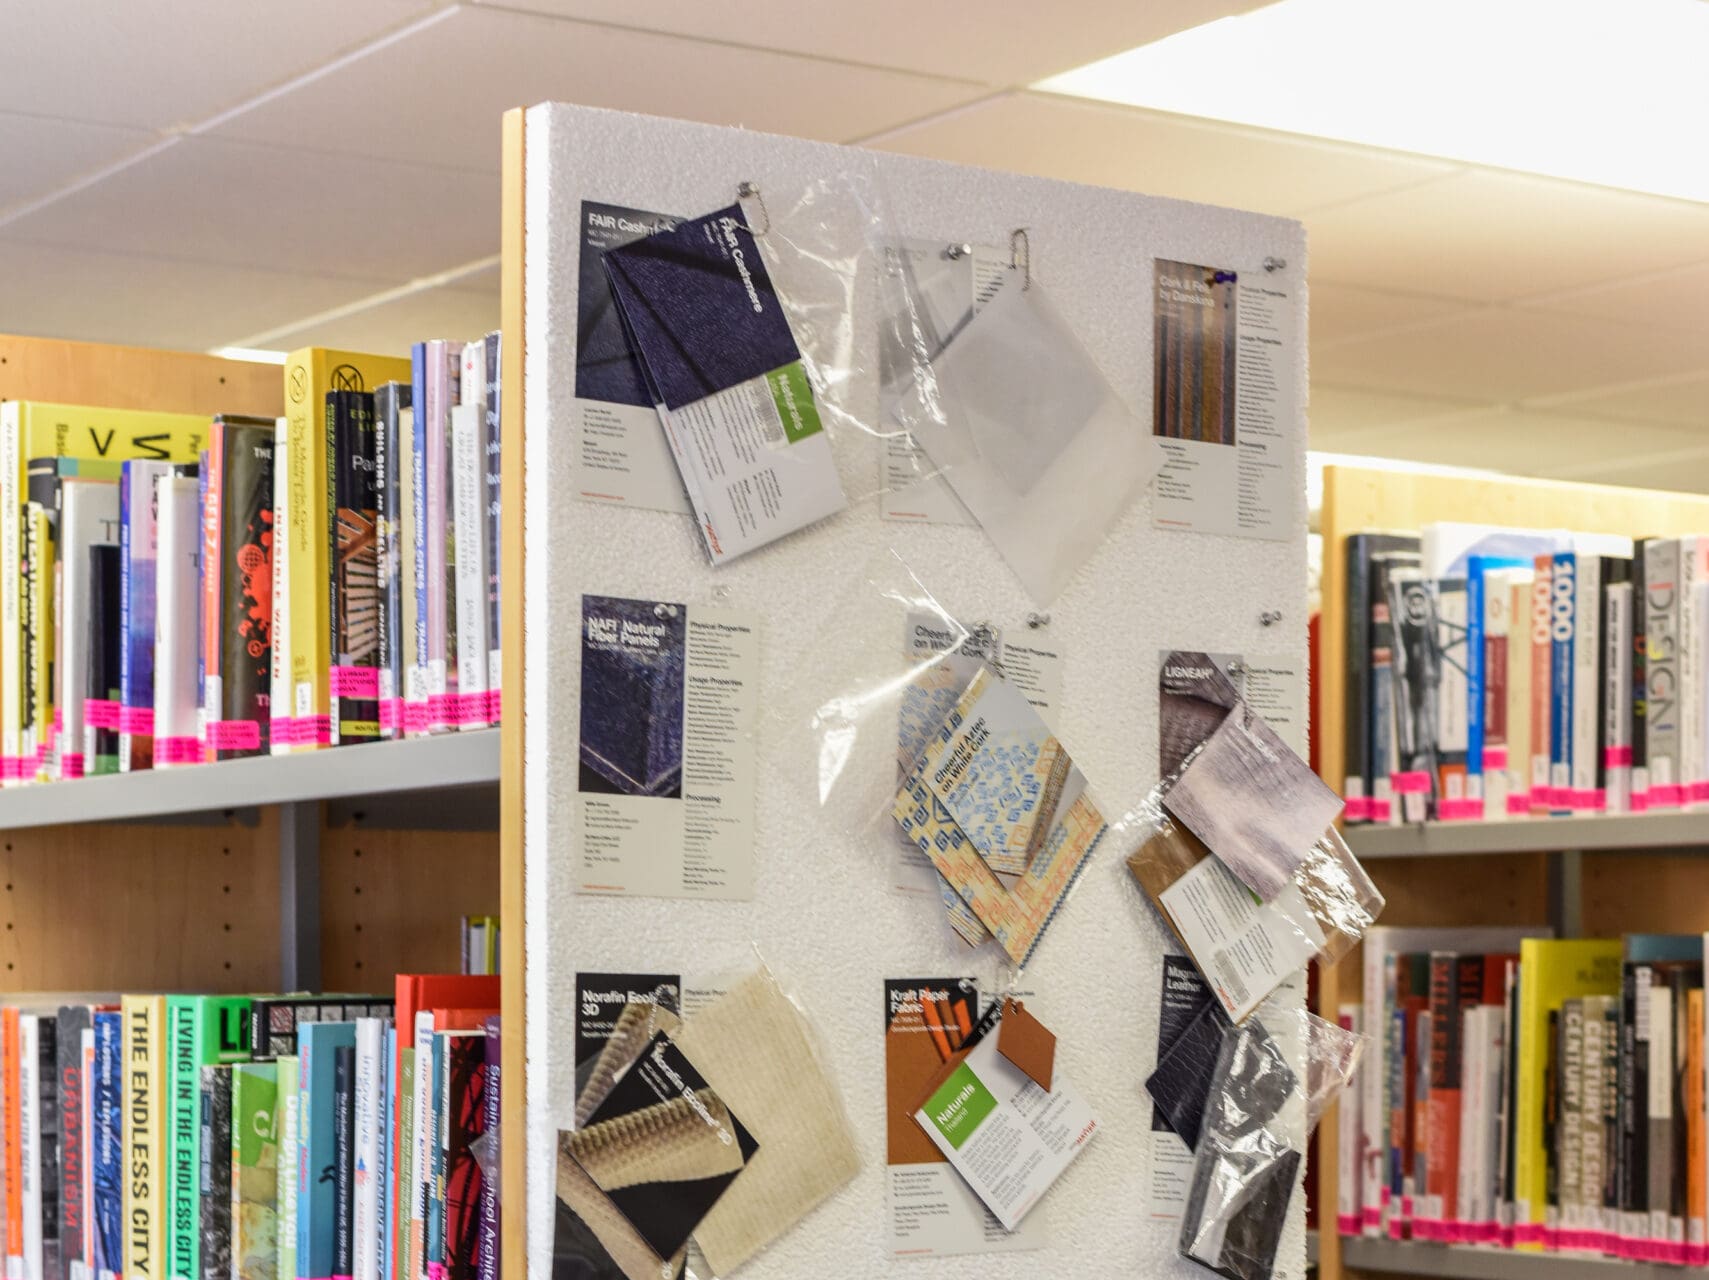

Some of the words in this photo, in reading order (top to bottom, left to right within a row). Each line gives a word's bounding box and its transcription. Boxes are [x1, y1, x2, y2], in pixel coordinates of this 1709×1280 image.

[588, 213, 616, 229] FAIR
[731, 249, 763, 314] Cashmere
[776, 373, 804, 431] Naturals
[205, 493, 219, 535] GEN
[274, 506, 283, 600] INVISIBLE
[622, 620, 666, 637] Natural
[1553, 560, 1574, 642] 1000
[273, 608, 282, 679] WOMEN
[588, 630, 618, 643] Fiber
[621, 632, 660, 648] Panels
[933, 742, 971, 786] Cheerful
[582, 990, 626, 1004] Norafin
[890, 989, 917, 1002] Kraft
[918, 988, 949, 1003] Paper
[890, 1001, 924, 1014] Fabric
[132, 1007, 150, 1062] THE
[177, 1006, 194, 1072] LIVING
[1564, 1011, 1582, 1105] CENTURY
[177, 1080, 193, 1099] IN
[1584, 1020, 1602, 1123] CENTURY
[102, 1099, 112, 1165] EXPLOSIONS
[177, 1106, 193, 1140] THE
[284, 1095, 299, 1165] Design
[486, 1064, 502, 1162] Sustainable
[936, 1083, 976, 1126] Naturals
[63, 1067, 80, 1228] URBANISM
[131, 1071, 150, 1198] ENDLESS
[1563, 1111, 1581, 1187] DESIGN
[176, 1148, 193, 1231] ENDLESS
[284, 1171, 298, 1212] Like
[298, 1147, 309, 1193] Modern
[484, 1167, 500, 1227] School
[131, 1208, 150, 1275] CITY
[175, 1234, 193, 1280] CITY
[284, 1213, 298, 1249] You
